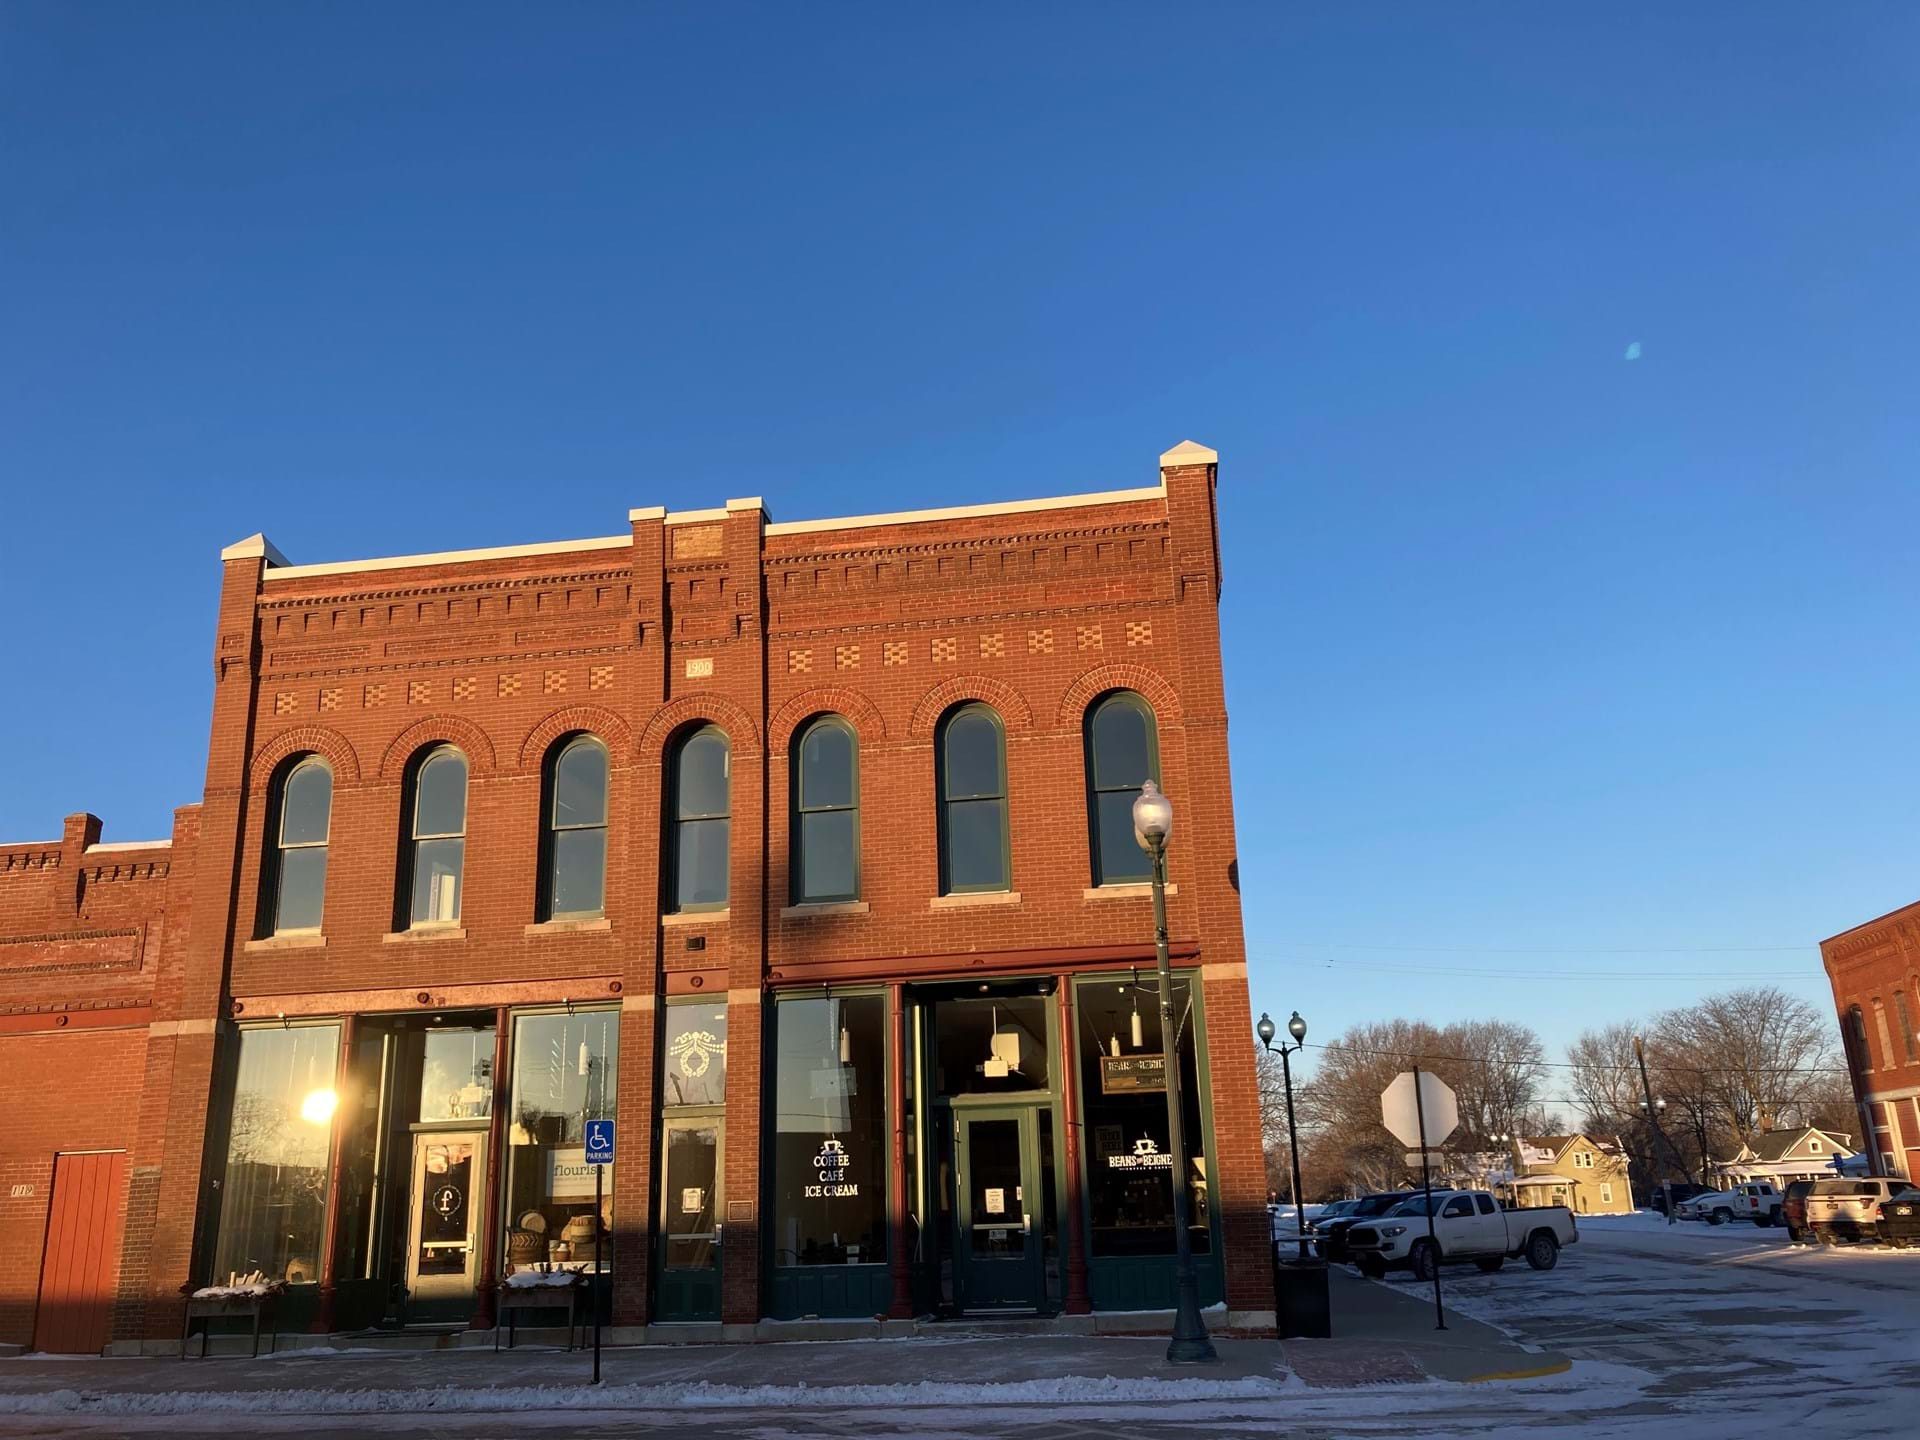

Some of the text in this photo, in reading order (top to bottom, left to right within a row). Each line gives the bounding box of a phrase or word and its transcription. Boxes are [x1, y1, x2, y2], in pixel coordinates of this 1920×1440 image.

[586, 1152, 612, 1160] PARKING
[813, 1155, 850, 1167] COFFEE
[1109, 1156, 1137, 1167] BEANS
[819, 1168, 844, 1181] CAFÉ
[805, 1184, 858, 1197] ICE CREAM
